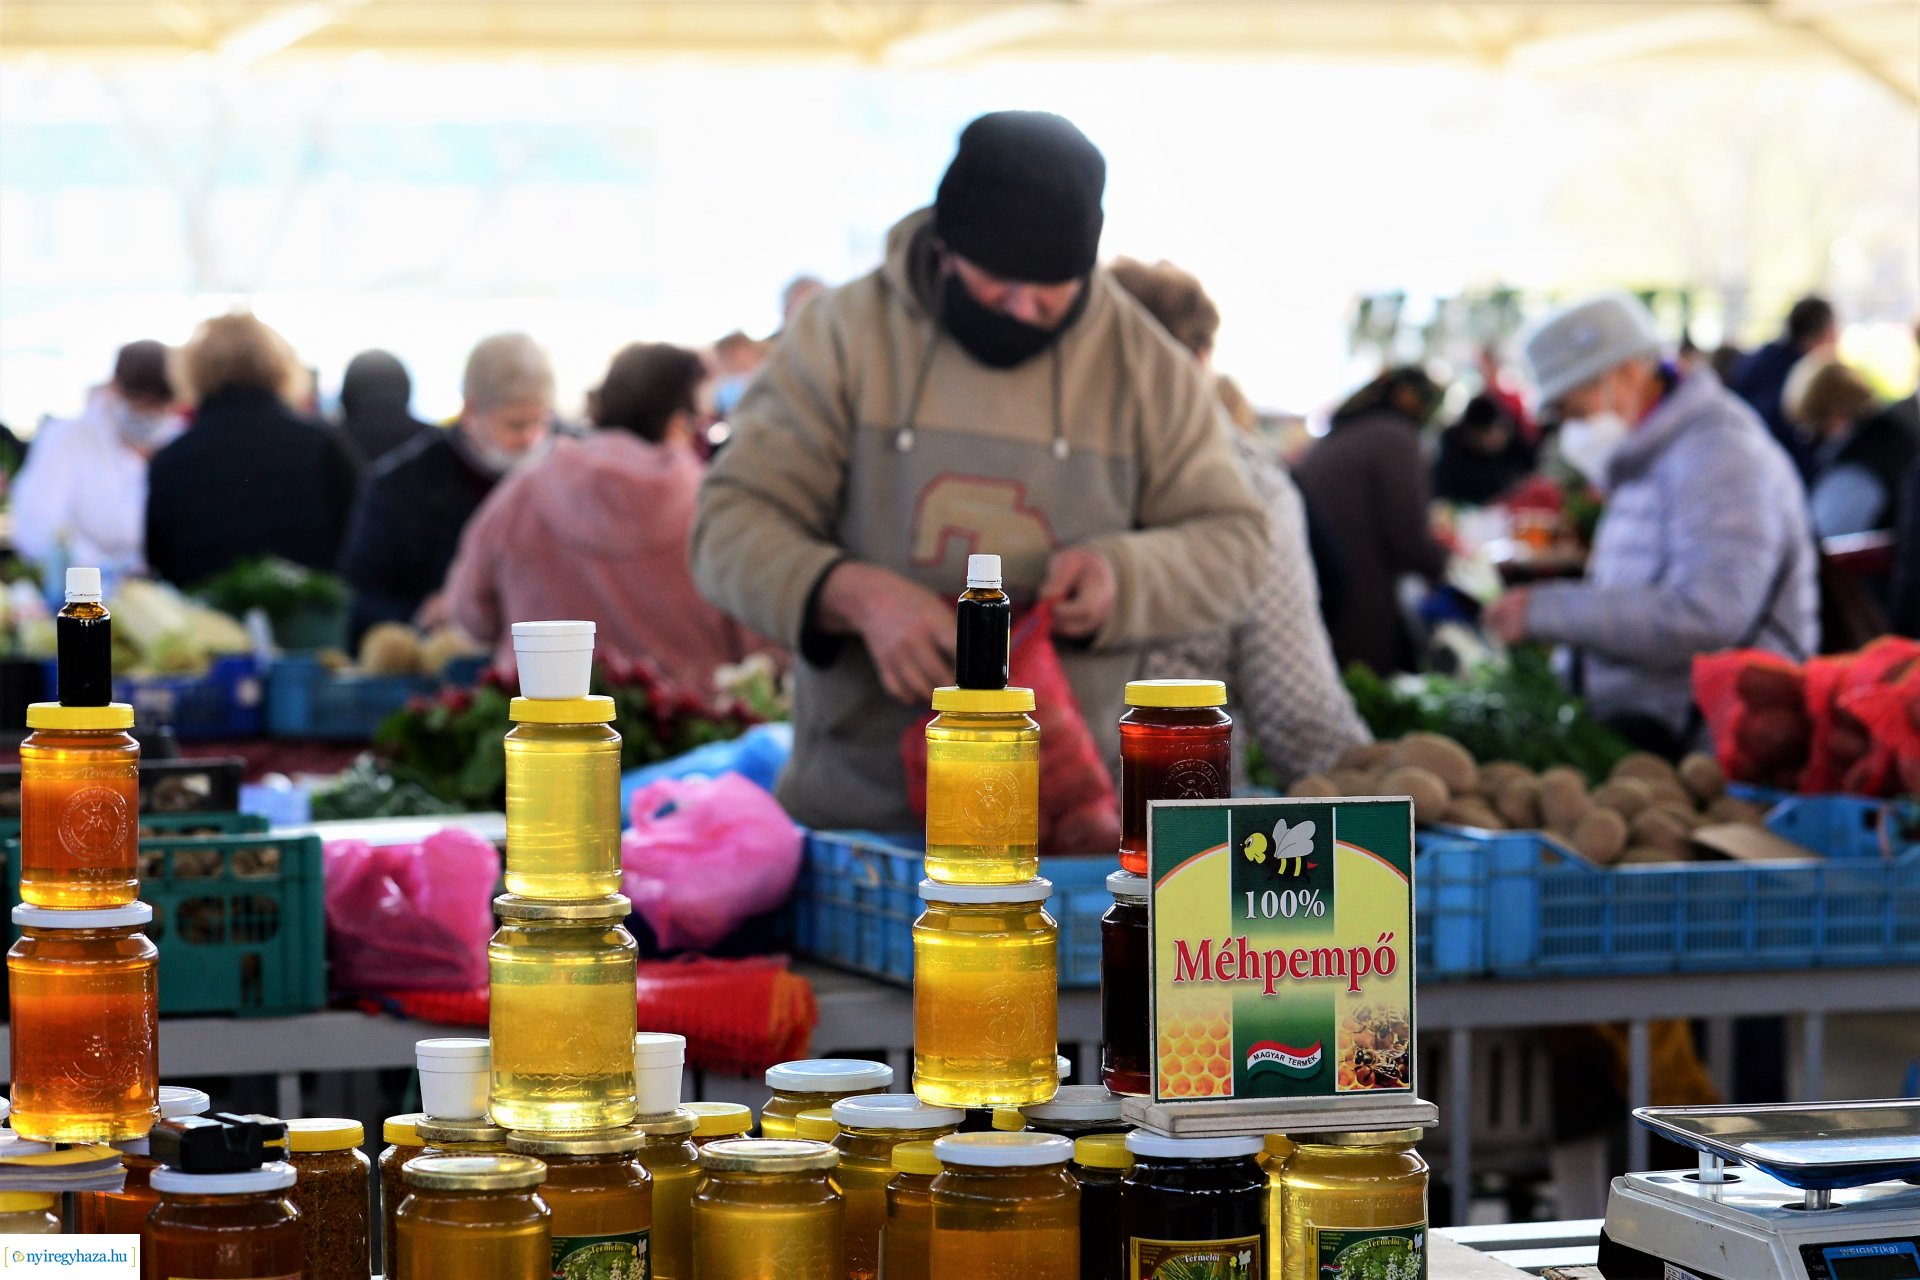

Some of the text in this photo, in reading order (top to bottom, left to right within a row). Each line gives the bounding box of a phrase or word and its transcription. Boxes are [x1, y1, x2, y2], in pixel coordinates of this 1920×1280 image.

[1244, 888, 1326, 919] 100%
[1172, 931, 1397, 995] Méhpempő
[1253, 1051, 1318, 1067] MAGYAR TERMÉK
[1840, 1245, 1899, 1256] WEIGHT(kg)
